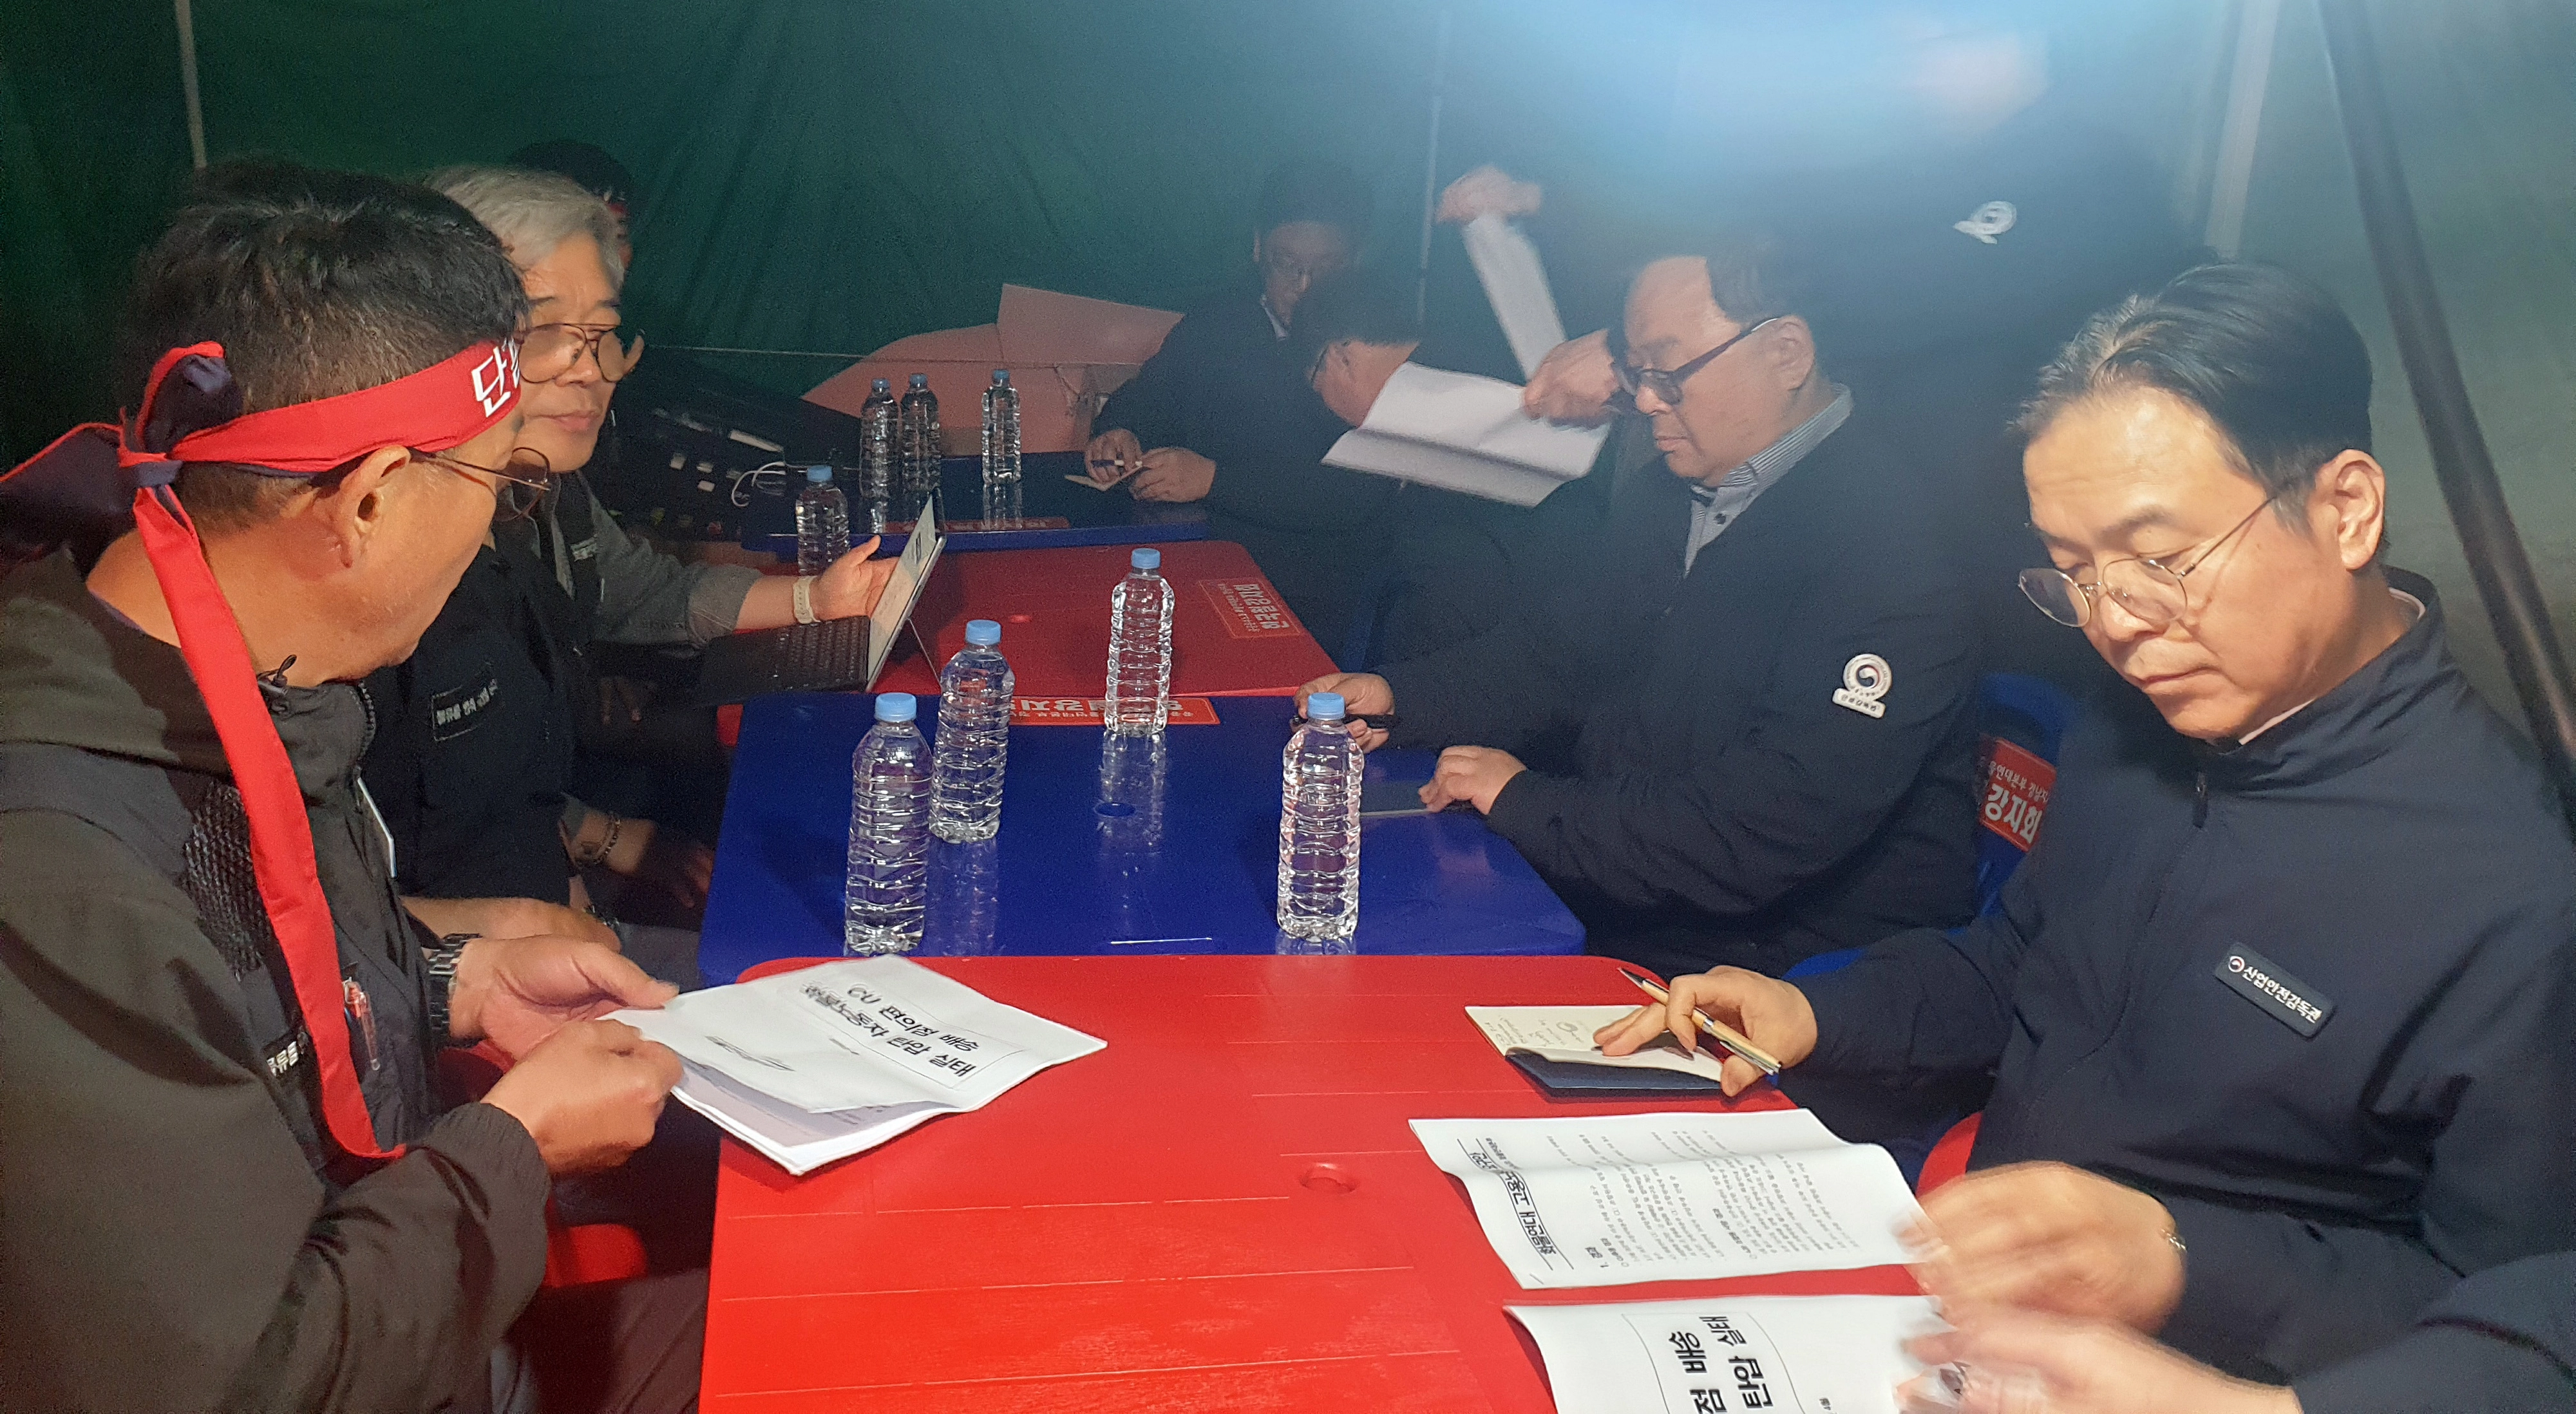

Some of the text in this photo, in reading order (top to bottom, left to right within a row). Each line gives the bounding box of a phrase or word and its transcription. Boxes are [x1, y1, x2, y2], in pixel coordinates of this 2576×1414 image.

[2242, 966, 2322, 1023] 산업안전감독관
[879, 1005, 940, 1037] 편의점
[939, 1034, 980, 1051] 배송
[887, 1036, 931, 1055] 탄압
[929, 1053, 976, 1077] 실태
[1519, 1211, 1557, 1254] 화물연대
[1669, 1331, 1707, 1373] 배송
[1699, 1316, 1774, 1409] 탄압 실태
